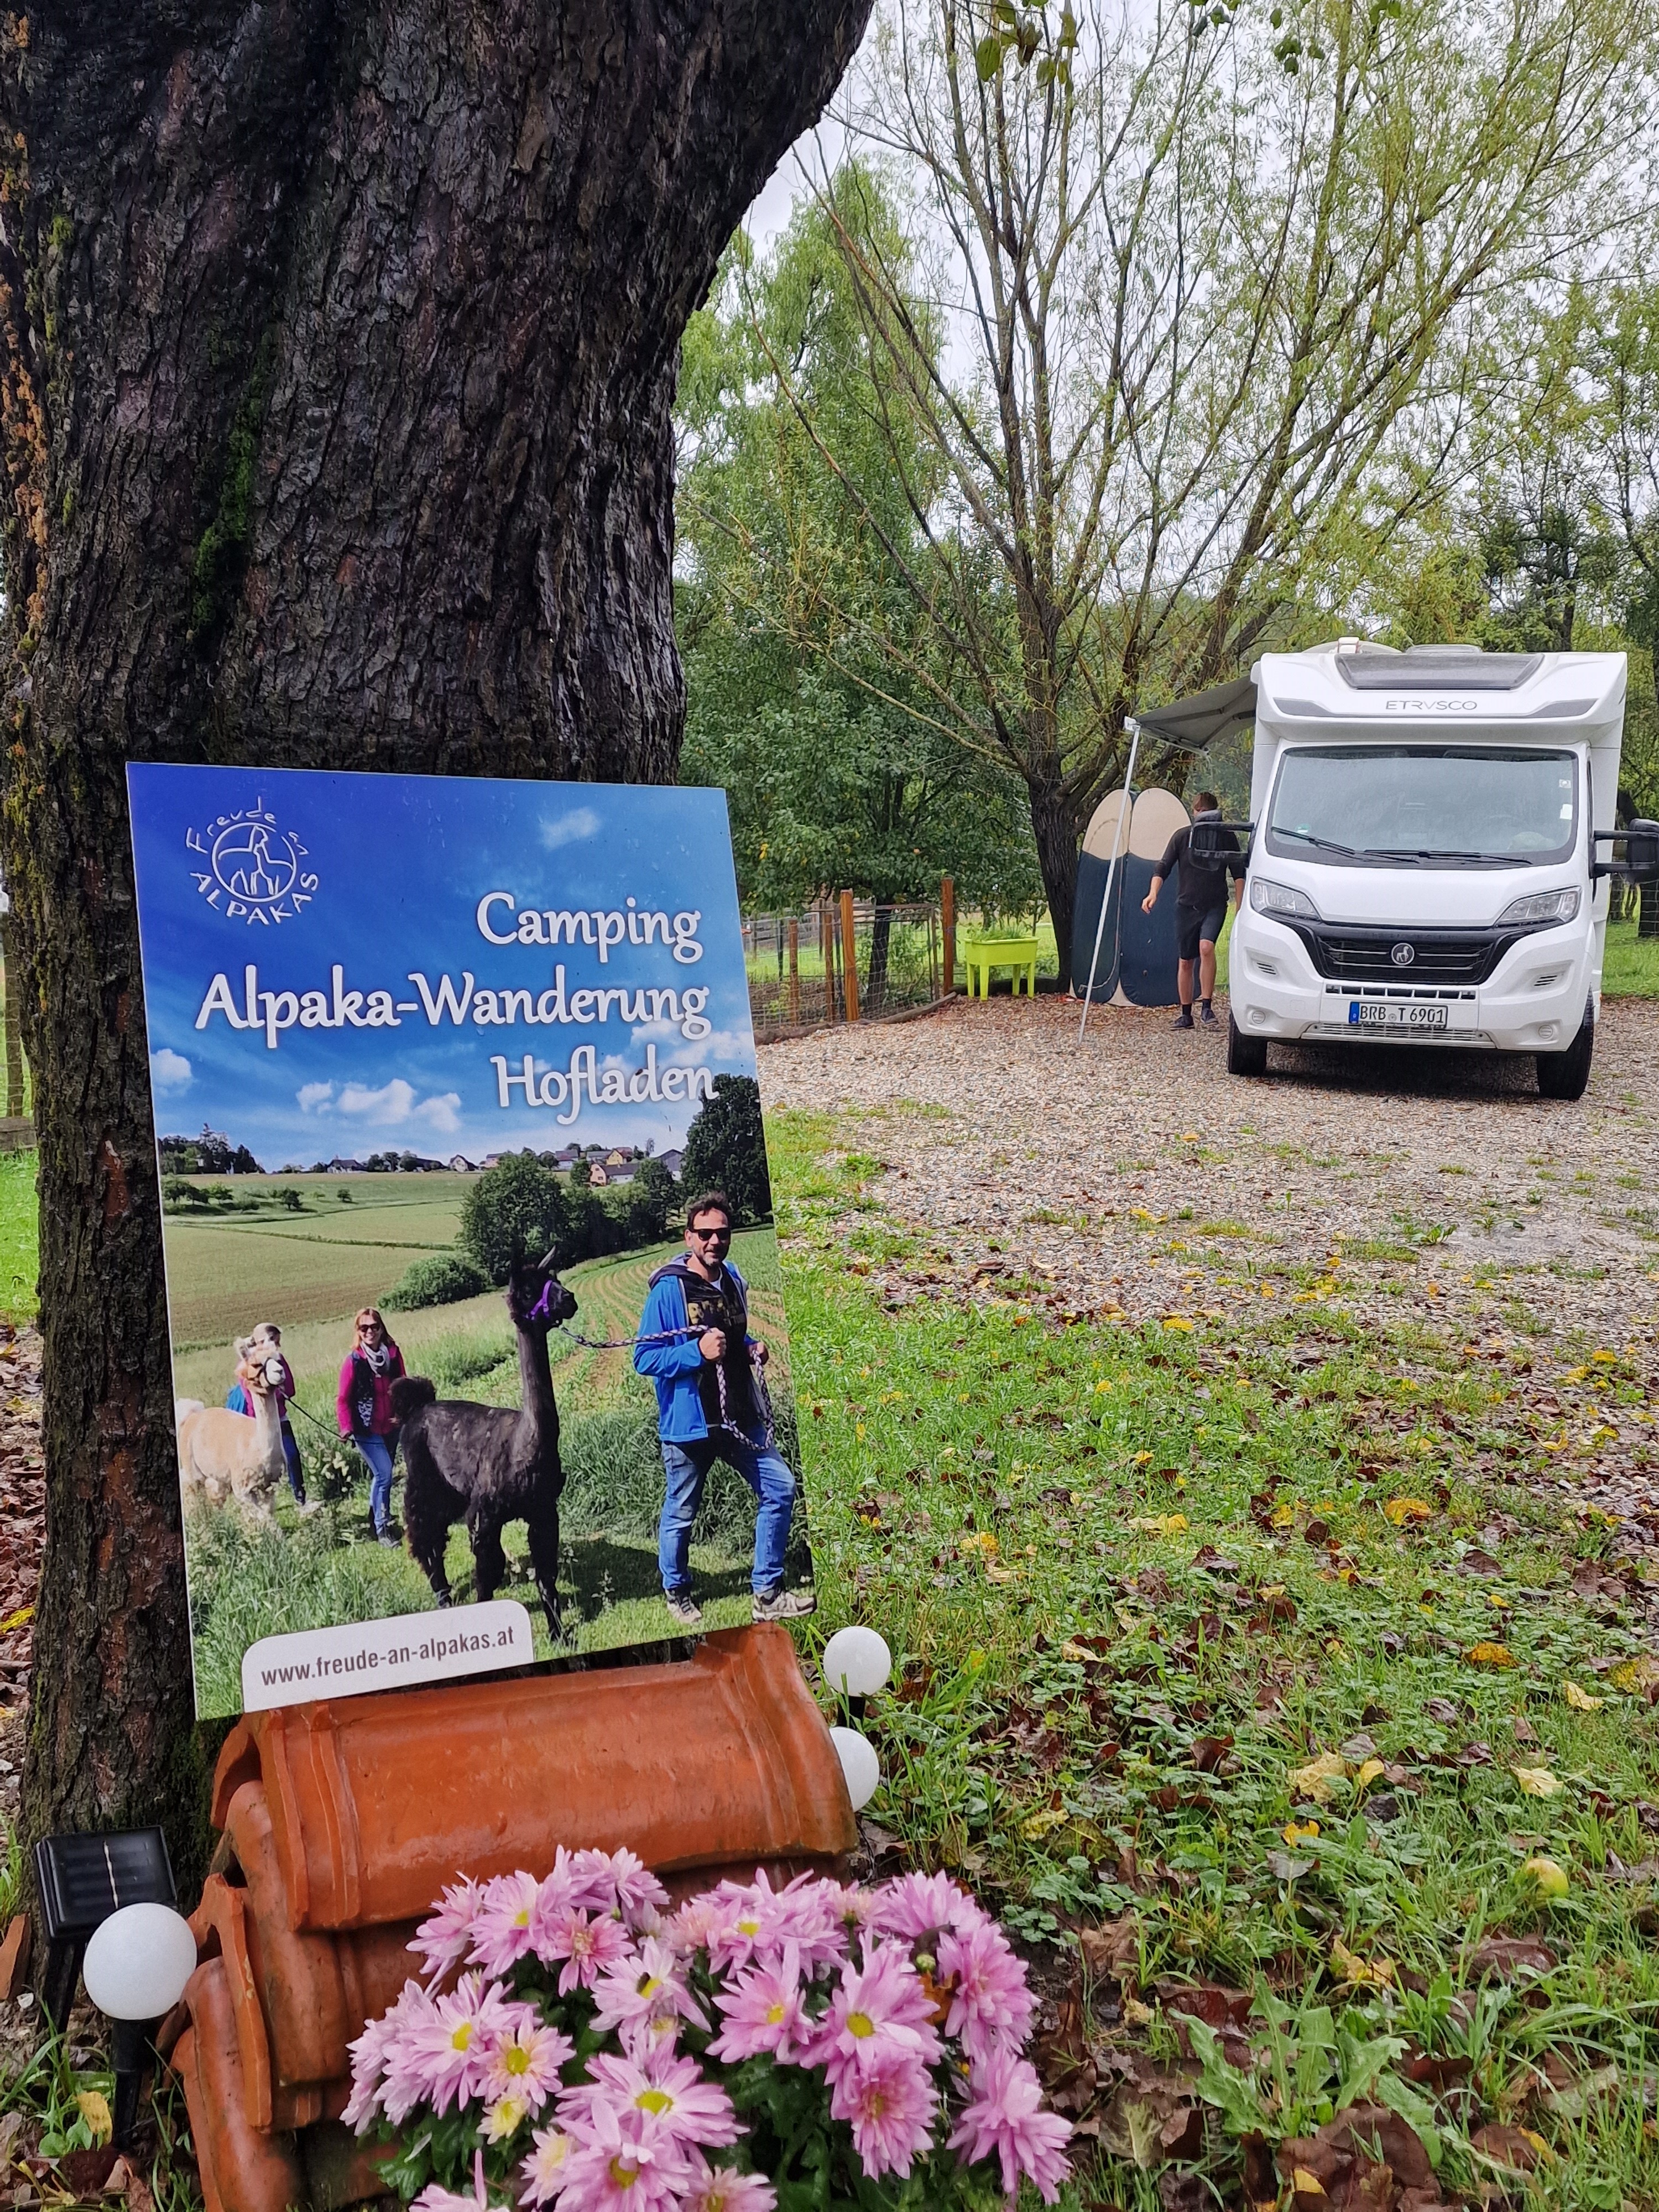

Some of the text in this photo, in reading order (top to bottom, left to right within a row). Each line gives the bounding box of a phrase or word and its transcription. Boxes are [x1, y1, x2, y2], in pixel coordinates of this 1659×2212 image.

[288, 831, 310, 855] an
[189, 871, 320, 925] ALPAKAS
[476, 891, 704, 964] Camping
[195, 964, 712, 1049] Alpaka-Wanderung
[1360, 1005, 1386, 1020] BRB
[1397, 1007, 1406, 1021] T
[1410, 1008, 1444, 1023] 6901
[489, 1044, 720, 1125] Hofladen
[261, 1626, 515, 1687] www.freude-an-alpakas.at
